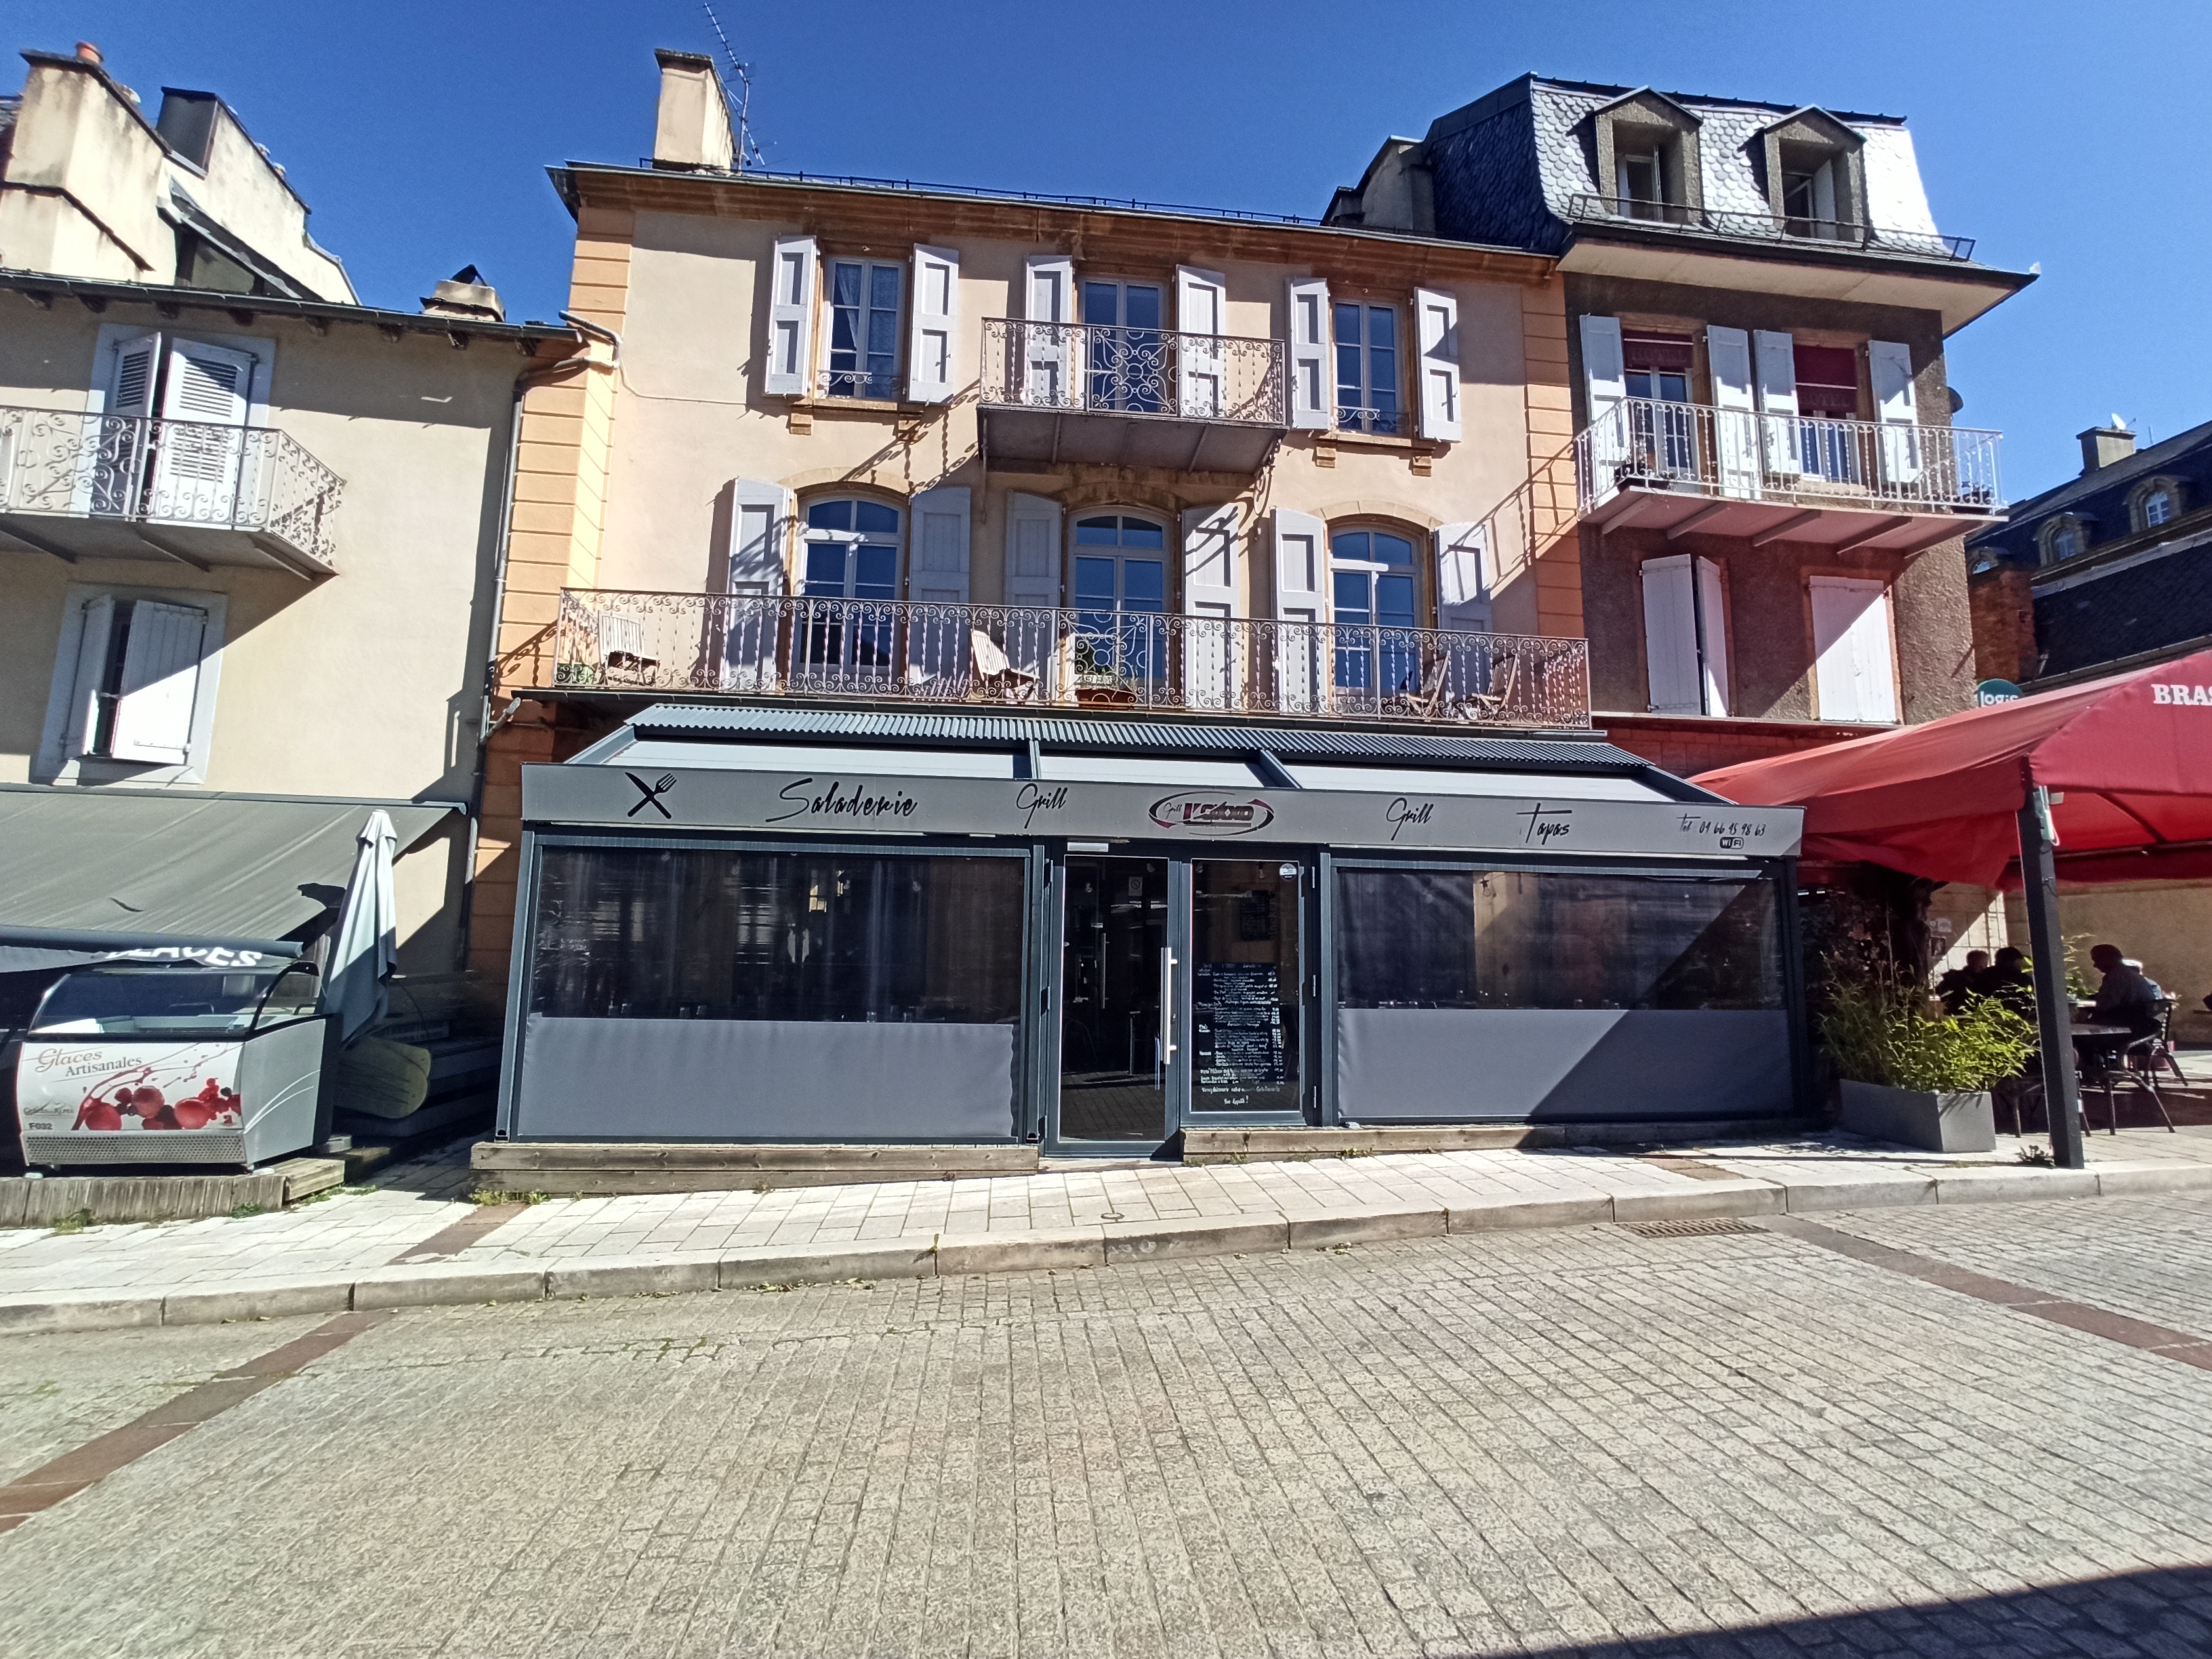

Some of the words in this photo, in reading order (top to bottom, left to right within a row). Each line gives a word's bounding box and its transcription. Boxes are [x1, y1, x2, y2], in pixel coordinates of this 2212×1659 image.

[2151, 684, 2212, 705] BRA
[765, 777, 918, 823] Saladerie
[1017, 783, 1068, 830] Grill
[1163, 802, 1183, 820] Grill
[1386, 797, 1434, 841] Grill
[1516, 802, 1572, 845] Tapas
[1699, 821, 1712, 834] 04
[1713, 821, 1725, 835] 66
[1728, 822, 1739, 836] 45
[1742, 823, 1753, 836] 98
[1754, 823, 1767, 837] 63
[35, 1048, 103, 1073] Glaces
[65, 1057, 142, 1077] Artisanales
